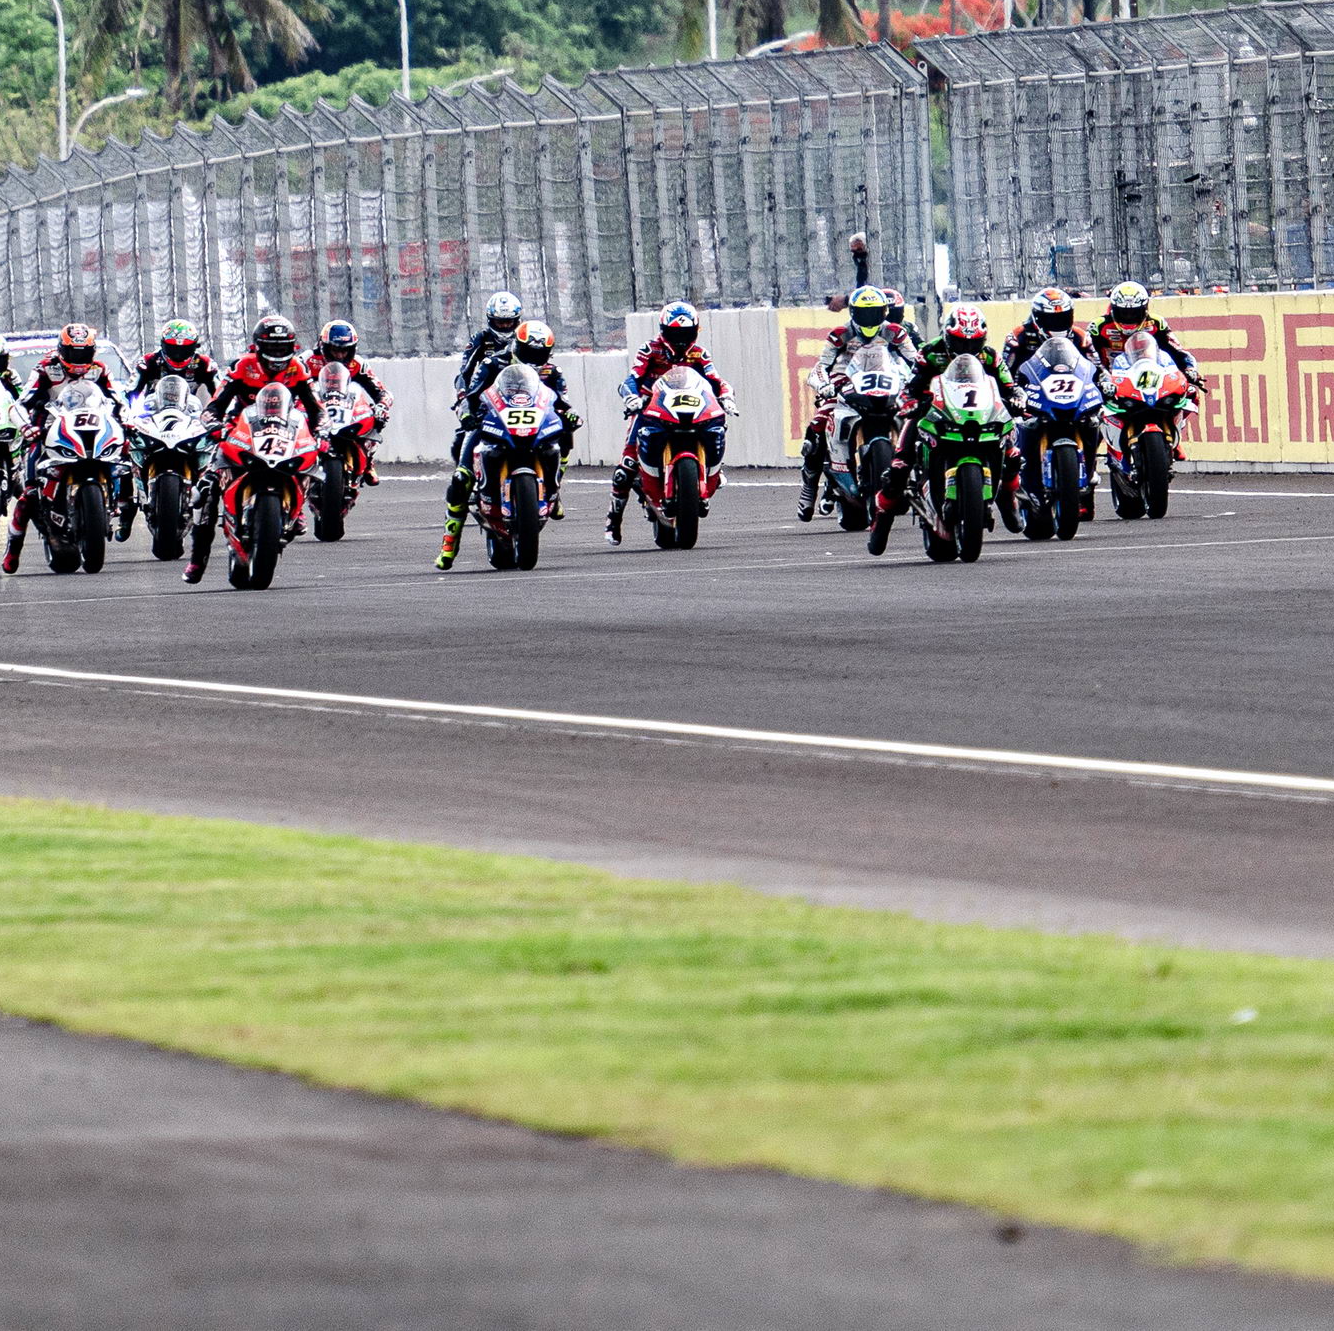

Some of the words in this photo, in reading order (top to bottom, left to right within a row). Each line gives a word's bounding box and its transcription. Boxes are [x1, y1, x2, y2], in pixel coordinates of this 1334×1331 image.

[861, 374, 893, 391] 36
[1049, 379, 1076, 393] 31
[672, 394, 700, 407] 19
[962, 390, 978, 408] 1
[74, 414, 100, 427] 60
[507, 410, 536, 425] 55
[258, 437, 289, 457] 45
